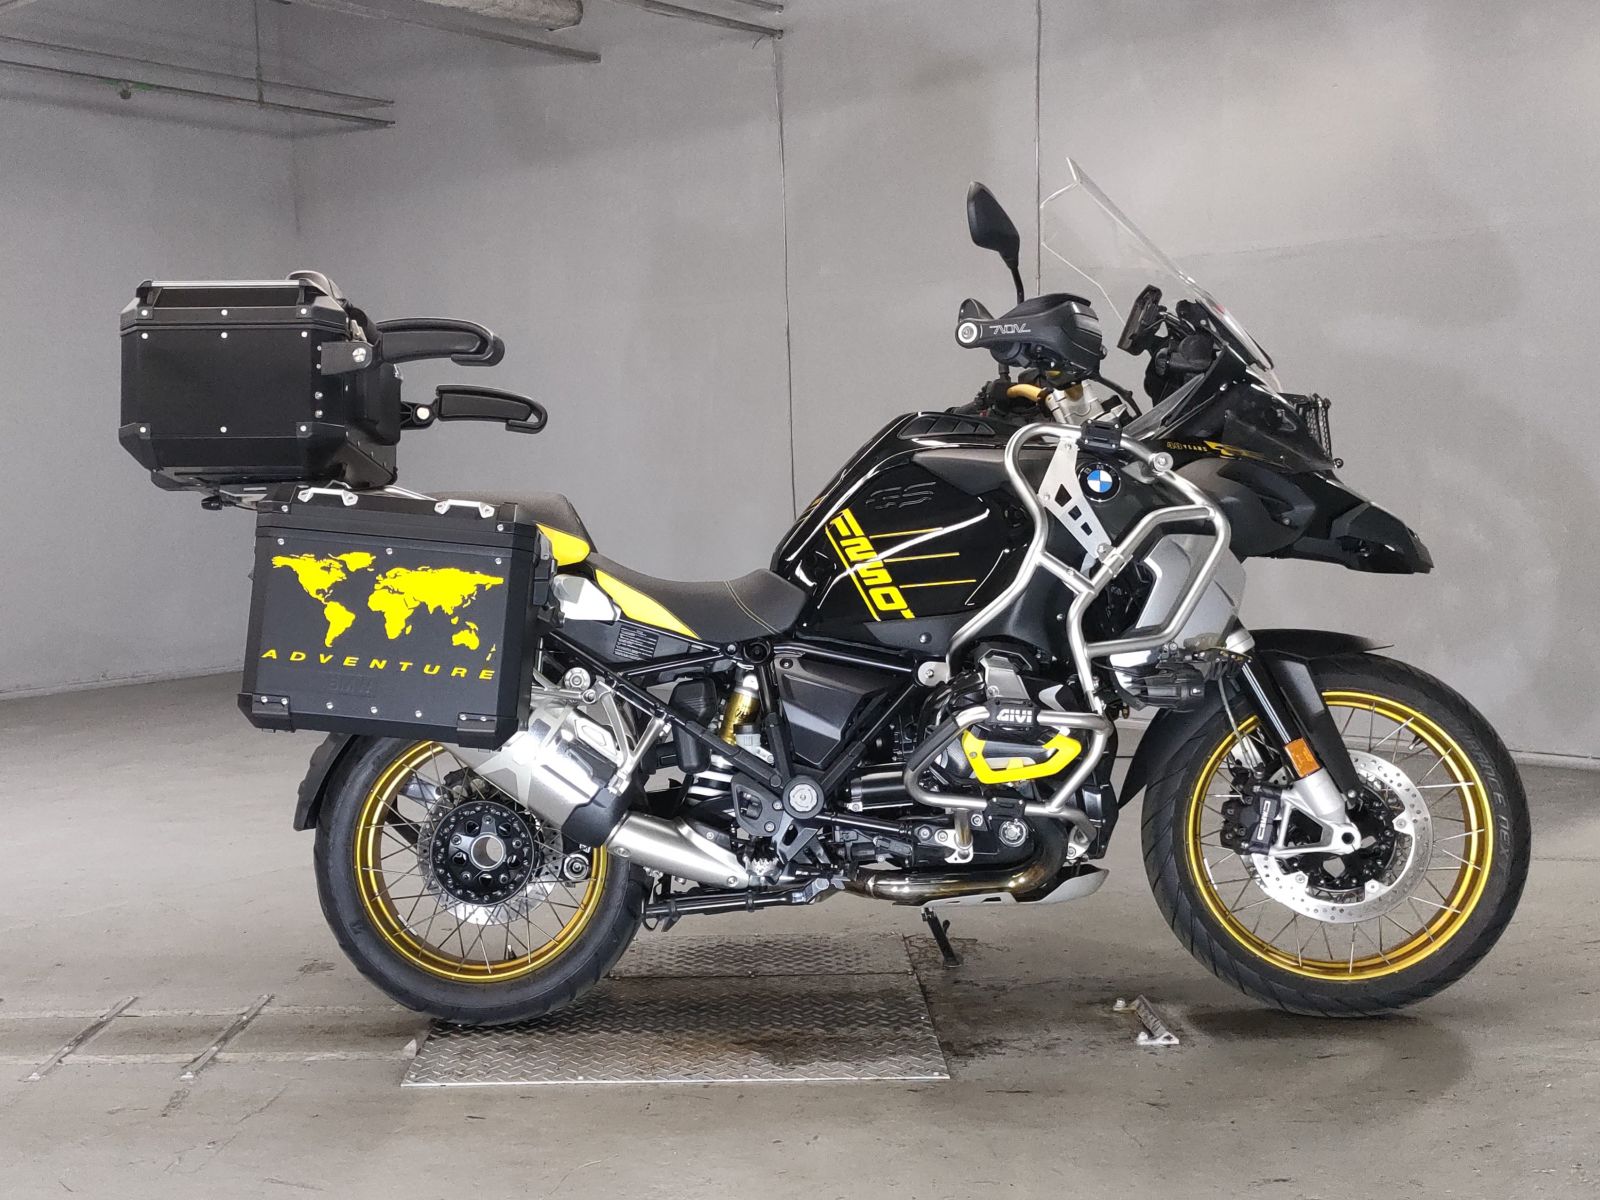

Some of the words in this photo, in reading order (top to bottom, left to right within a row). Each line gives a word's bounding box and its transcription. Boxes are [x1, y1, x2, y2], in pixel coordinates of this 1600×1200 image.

[1083, 464, 1116, 477] BMW
[261, 648, 494, 681] ADVENTURE
[996, 708, 1032, 724] GIVI
